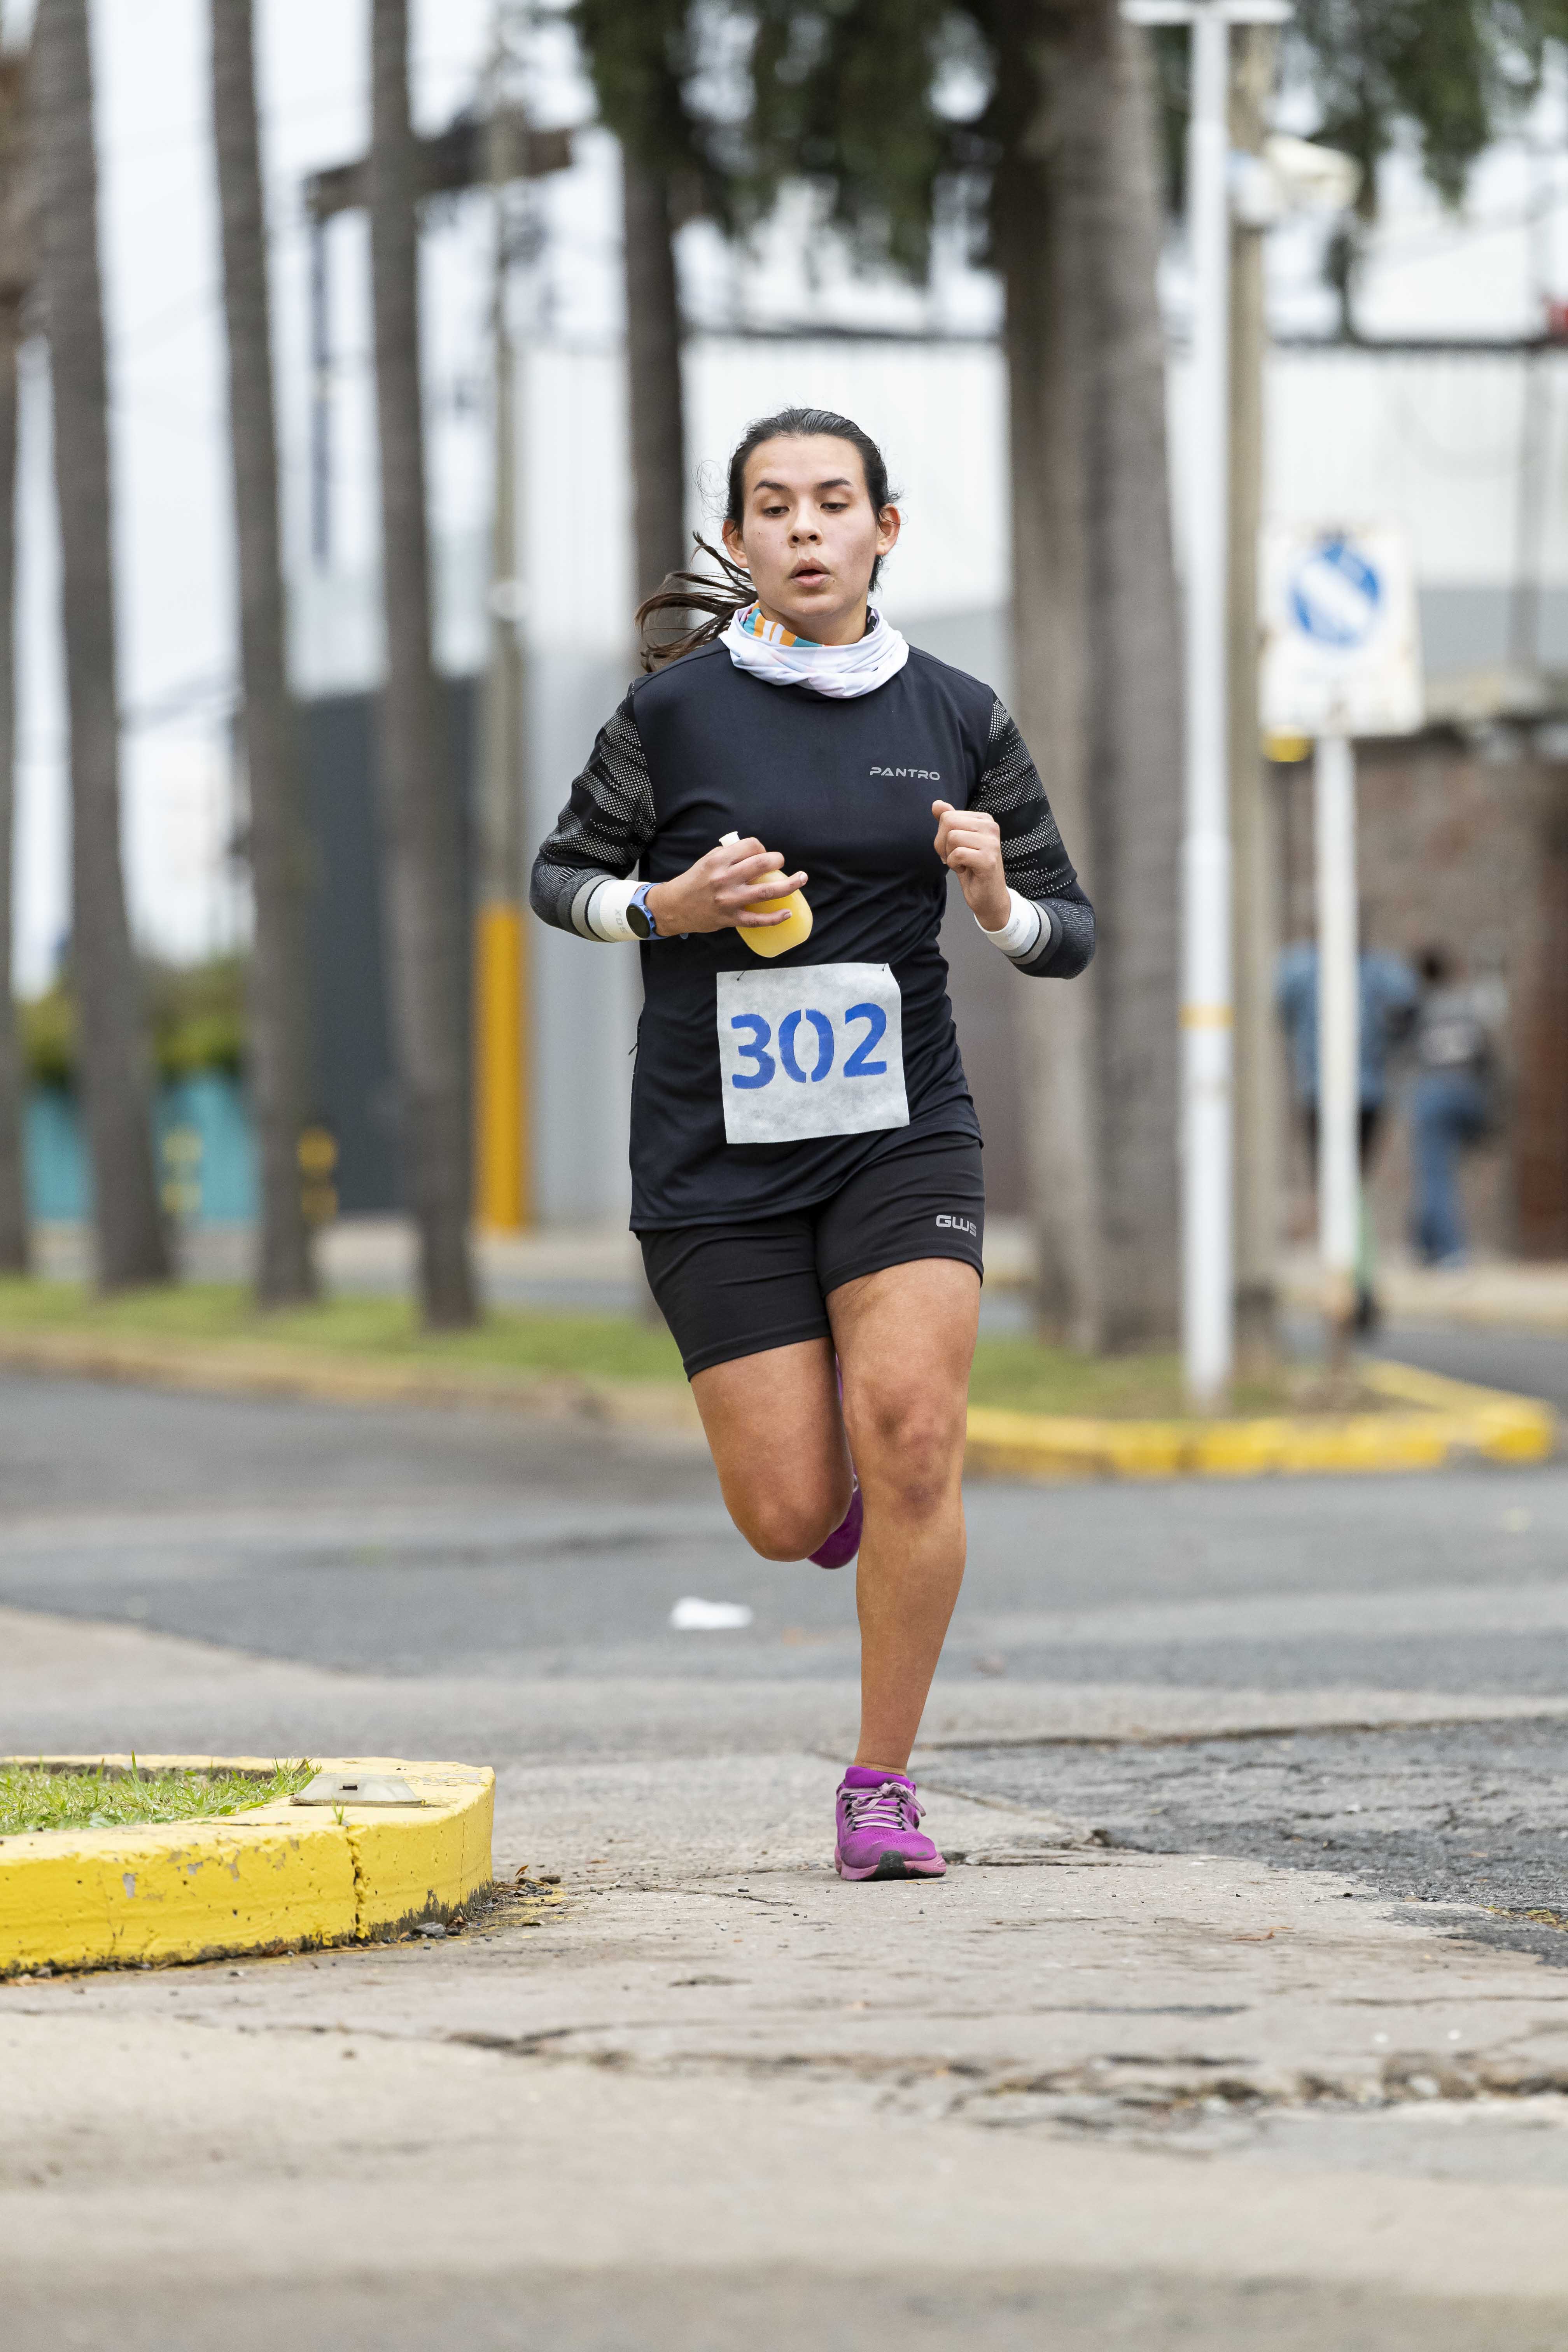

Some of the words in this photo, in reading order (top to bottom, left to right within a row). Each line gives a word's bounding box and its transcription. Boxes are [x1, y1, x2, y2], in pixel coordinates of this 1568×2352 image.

[870, 767, 940, 780] PANTRO
[731, 1003, 887, 1089] 302
[936, 1215, 976, 1237] GWS
